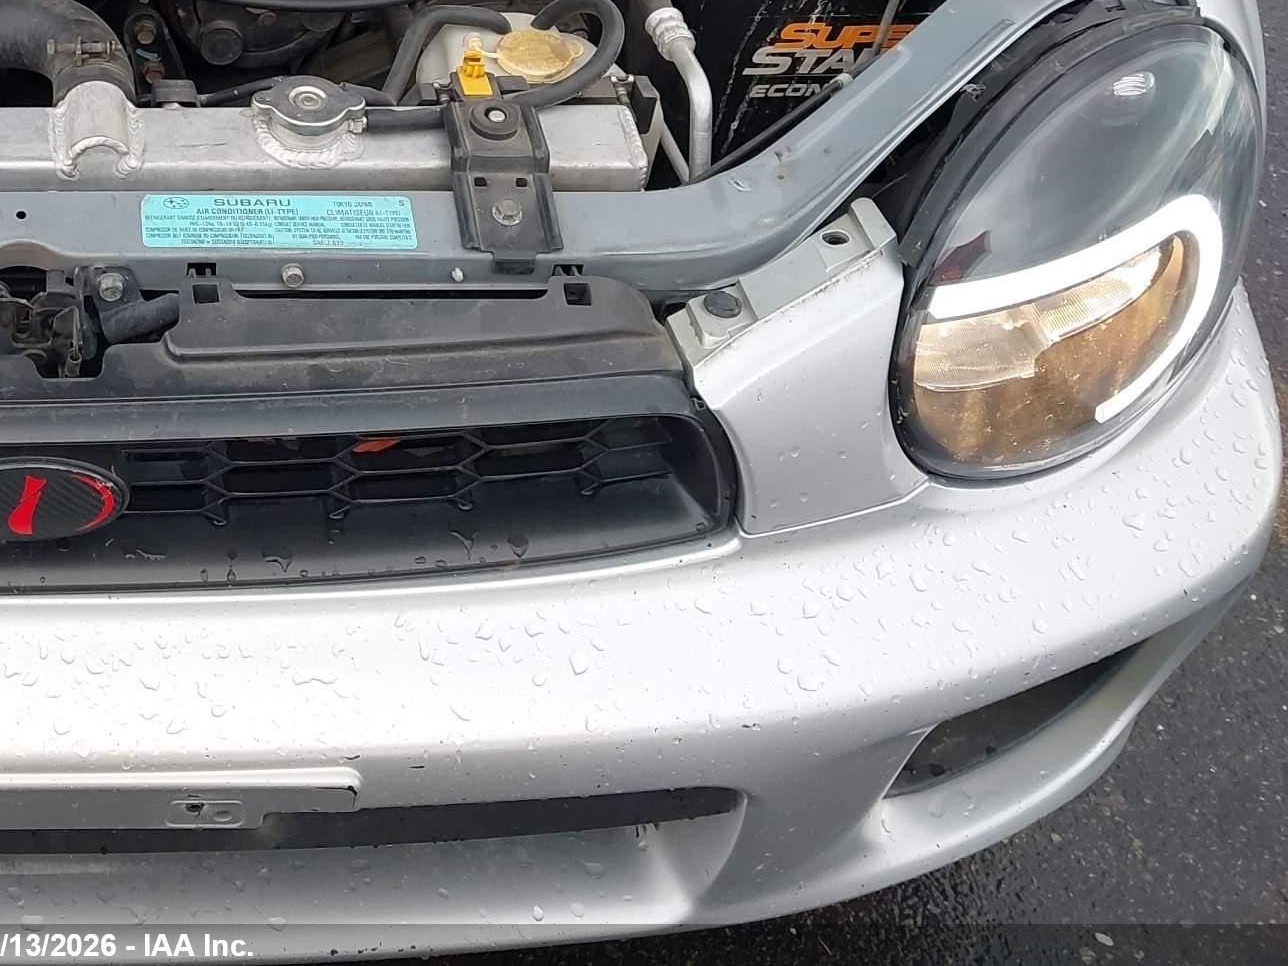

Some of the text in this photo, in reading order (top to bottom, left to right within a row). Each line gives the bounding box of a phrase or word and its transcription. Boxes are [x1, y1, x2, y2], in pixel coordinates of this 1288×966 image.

[214, 198, 291, 207] SUBARU
[399, 199, 405, 207] S
[327, 209, 374, 217] CLIMATISEUR
